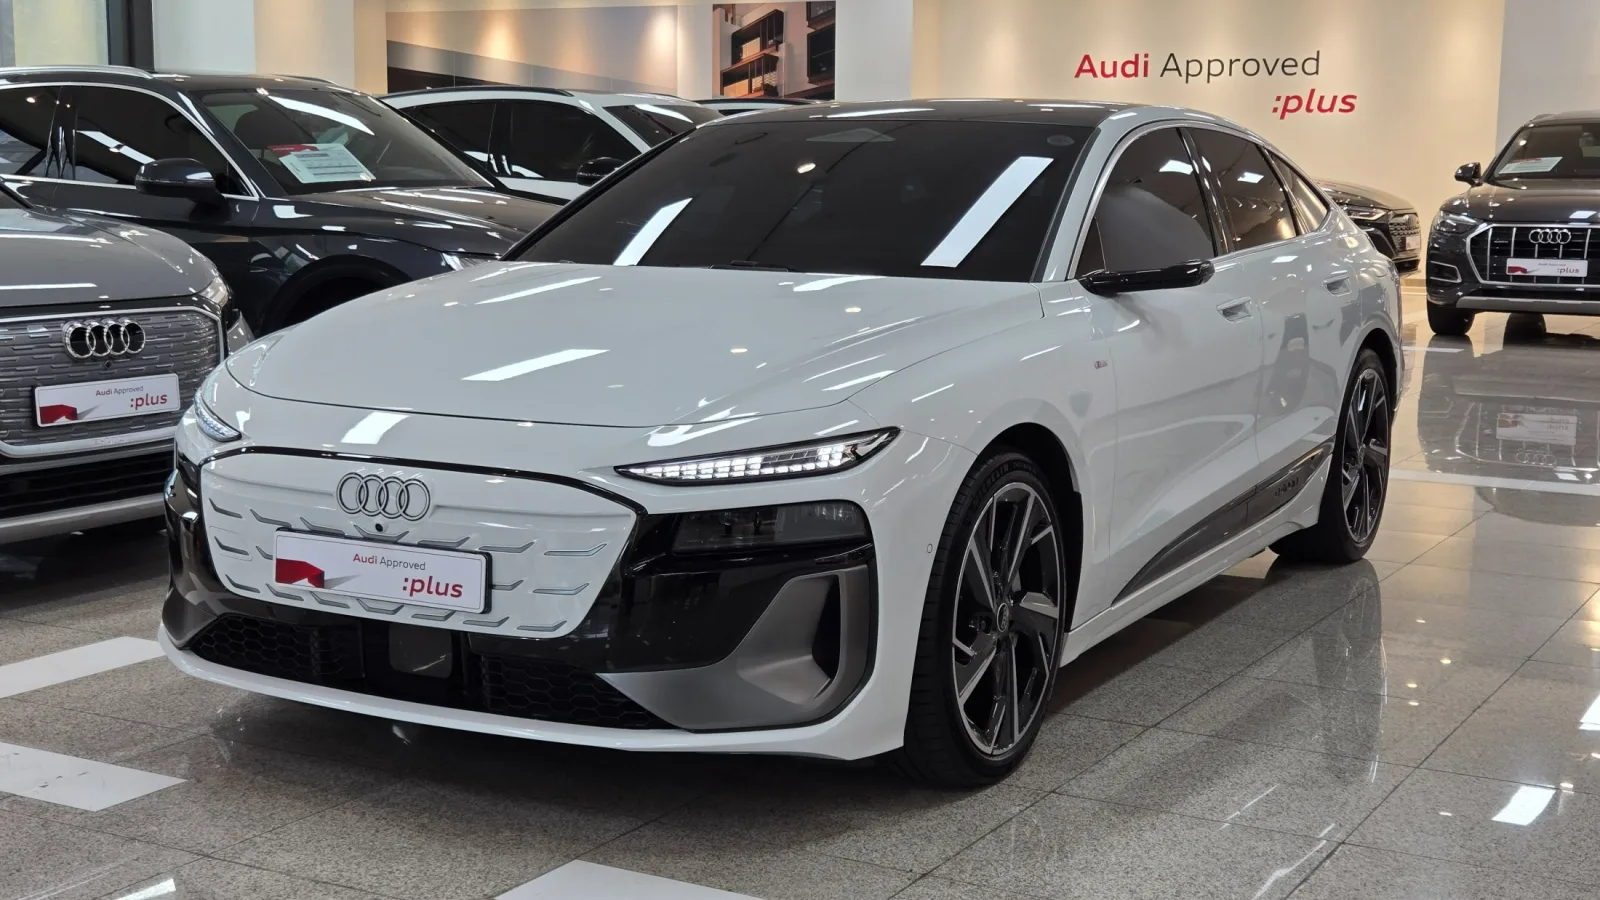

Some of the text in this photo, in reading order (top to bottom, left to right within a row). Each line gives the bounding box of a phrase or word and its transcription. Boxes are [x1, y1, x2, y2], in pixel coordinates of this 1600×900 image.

[1074, 50, 1320, 84] Audi Approved
[1271, 88, 1358, 120] :plus
[95, 386, 144, 397] Audi Approved
[130, 393, 168, 410] :plus
[353, 553, 426, 571] Audi Approved
[402, 575, 463, 598] :plus
